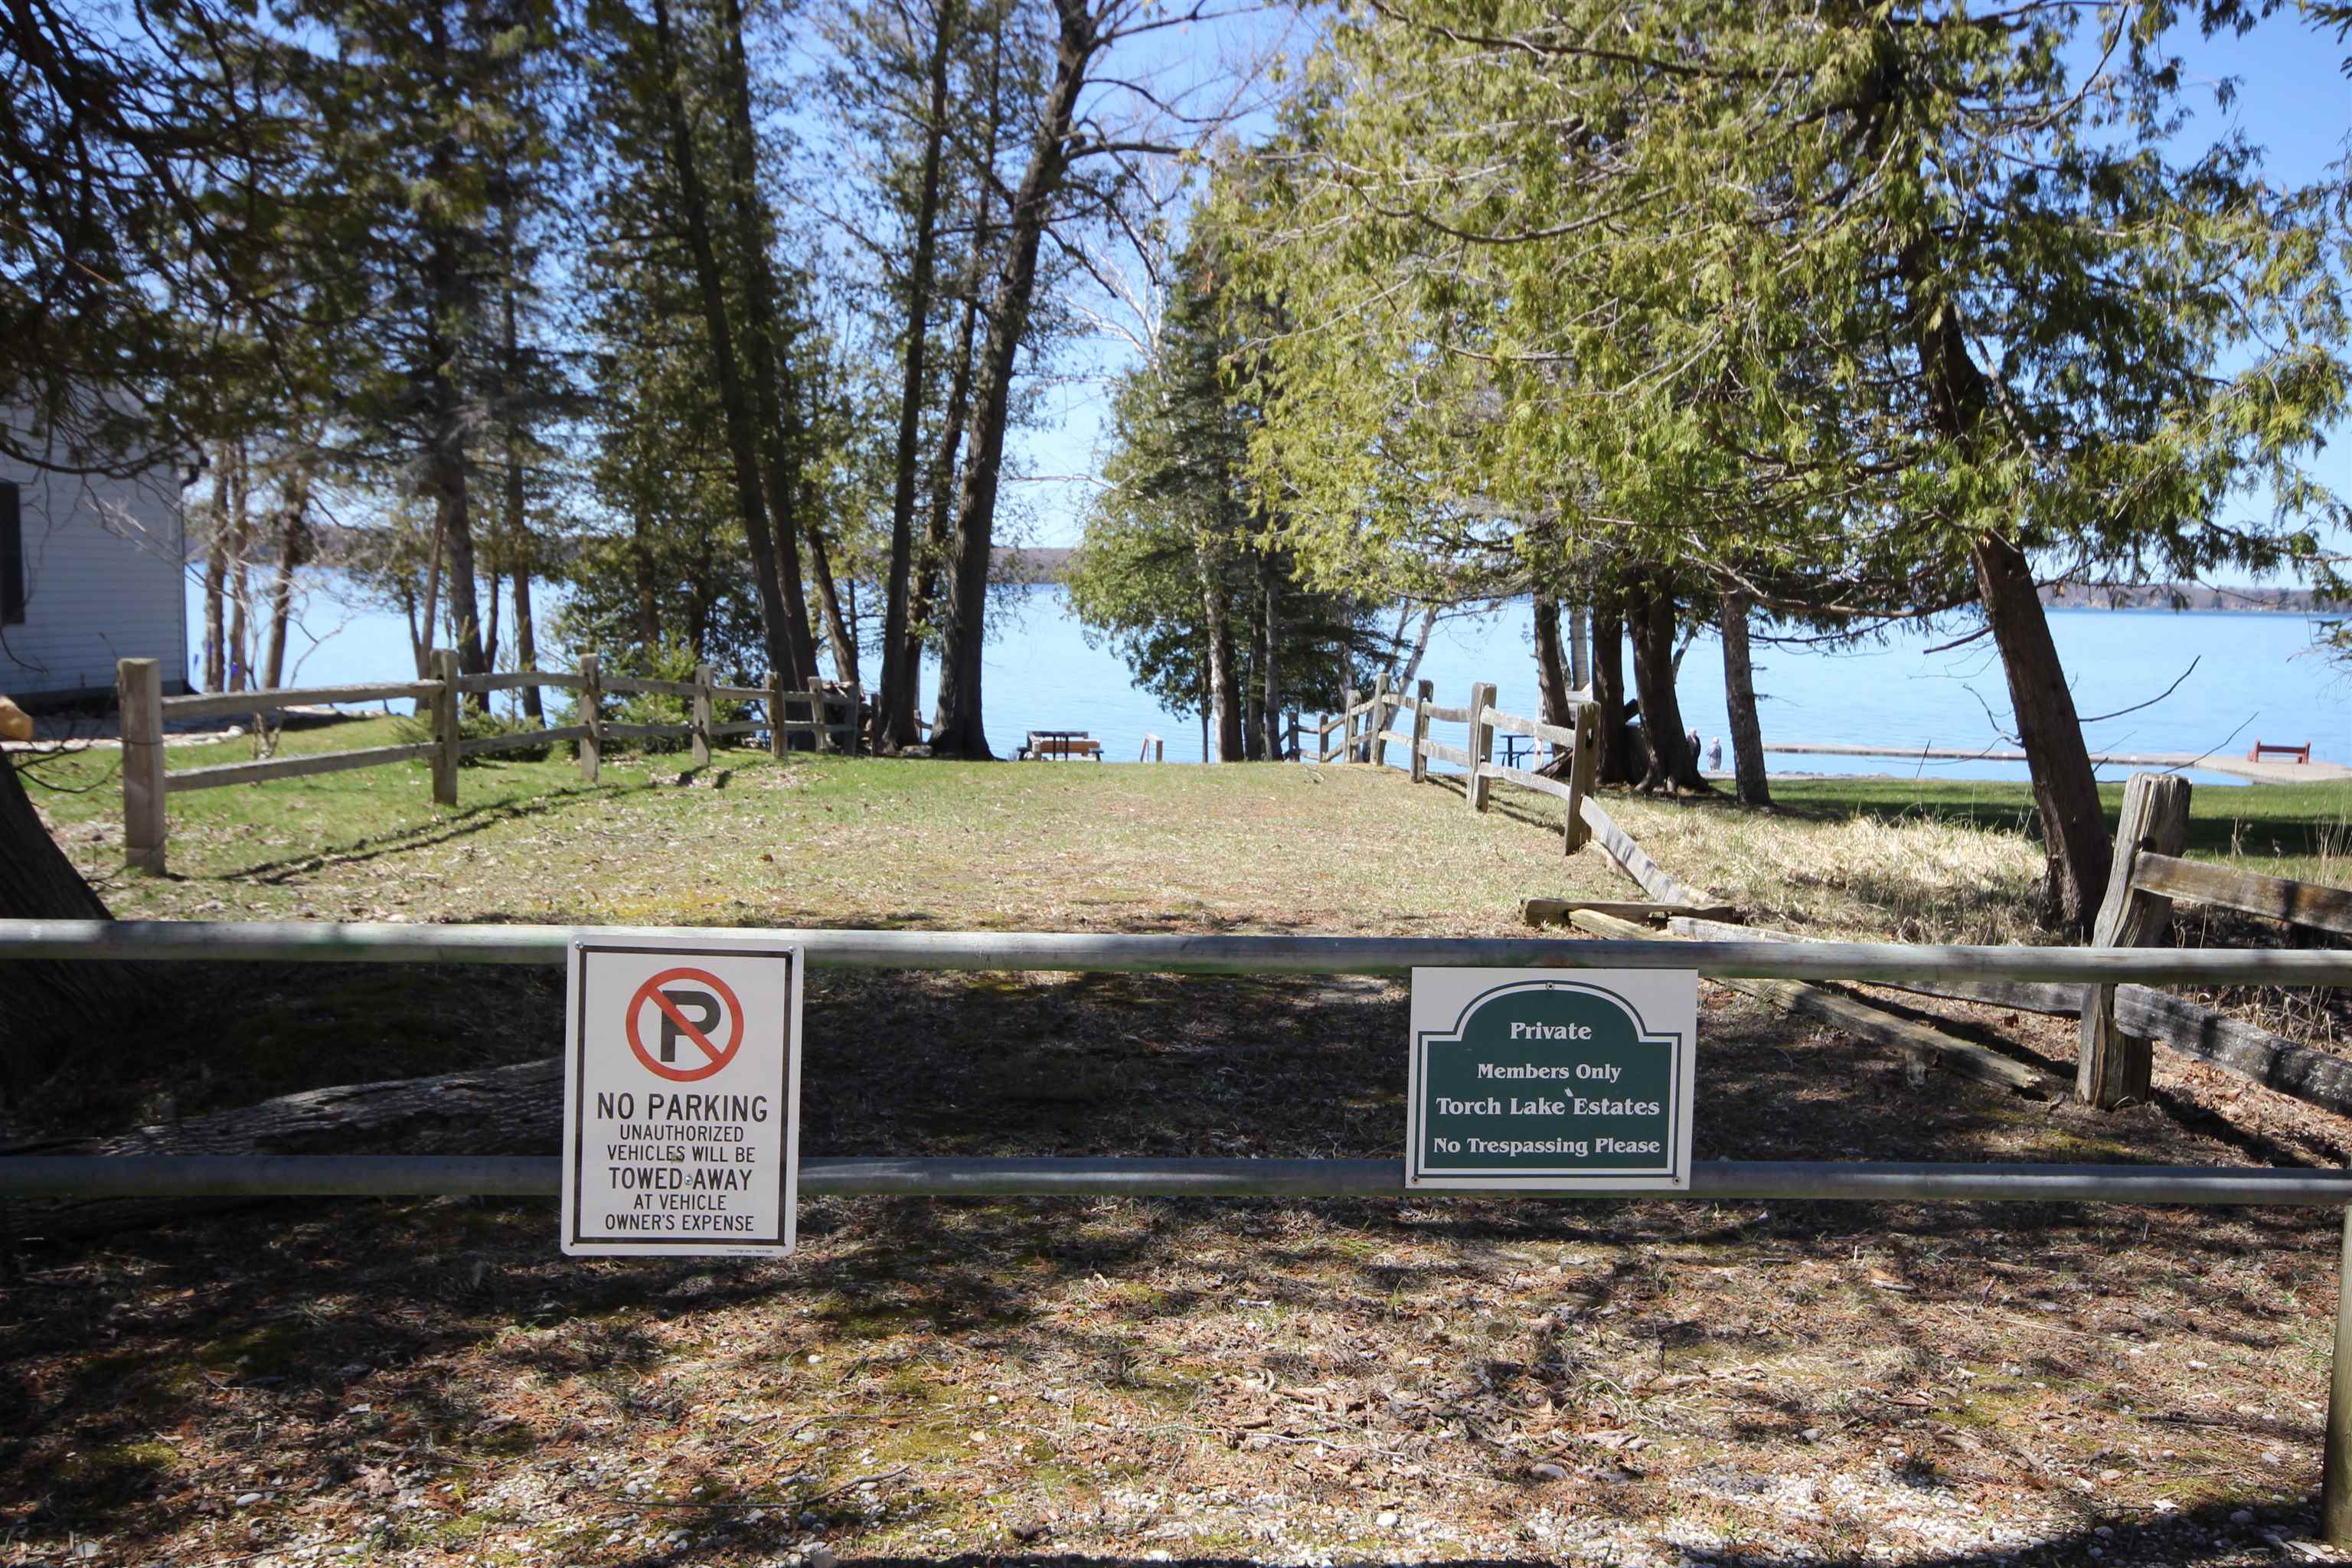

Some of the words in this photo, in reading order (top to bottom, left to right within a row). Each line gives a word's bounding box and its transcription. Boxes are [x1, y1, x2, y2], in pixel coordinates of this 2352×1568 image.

[1510, 1021, 1592, 1040] Private
[1477, 1063, 1570, 1080] Members
[1576, 1063, 1622, 1083] Only
[597, 1092, 635, 1120] NO
[648, 1093, 767, 1122] PARKING
[1435, 1096, 1501, 1116] Torch
[1510, 1097, 1566, 1116] Lake
[1573, 1098, 1661, 1116] Estates
[619, 1124, 744, 1142] UNAUTHORIZED
[607, 1144, 685, 1161] VEHICLES
[691, 1145, 729, 1162] WILL
[735, 1146, 756, 1163] BE
[1433, 1138, 1461, 1153] No
[1466, 1137, 1589, 1158] Trespassing
[1595, 1137, 1661, 1153] Please
[608, 1167, 683, 1190] TOWED
[692, 1168, 753, 1191] AWAY
[633, 1194, 653, 1210] AT
[658, 1194, 727, 1211] VEHICLE
[605, 1214, 675, 1230] OWNER'S
[682, 1214, 754, 1232] EXPENSE
